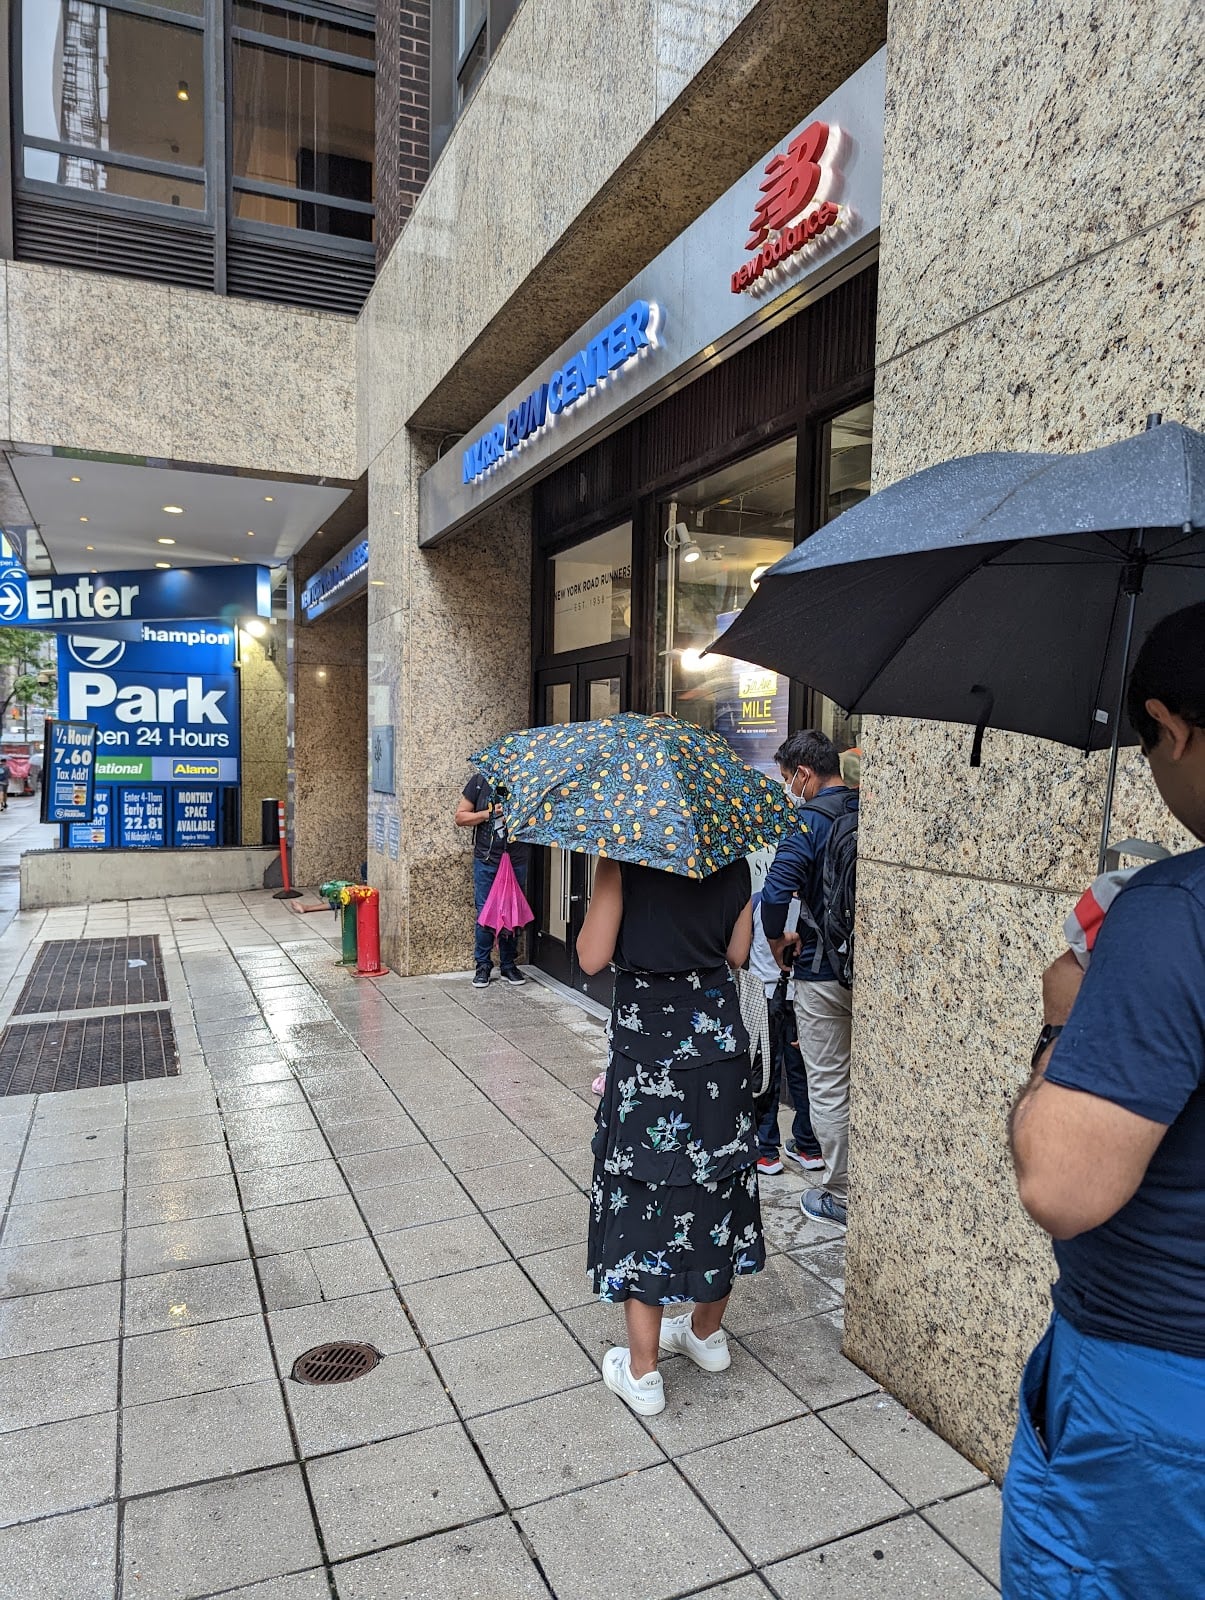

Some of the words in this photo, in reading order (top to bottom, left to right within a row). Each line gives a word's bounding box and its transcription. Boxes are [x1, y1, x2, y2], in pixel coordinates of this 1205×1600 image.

[731, 253, 764, 294] new
[763, 201, 838, 268] balance
[463, 423, 505, 484] NYRR
[505, 383, 549, 451] RUN
[548, 300, 650, 415] CENTER
[567, 582, 582, 598] YORK
[582, 577, 600, 592] ROAD
[601, 564, 631, 585] RUNNERS
[26, 577, 140, 619] Enter
[141, 626, 230, 646] hampion
[69, 671, 229, 725] Park
[742, 699, 772, 719] MILE
[68, 729, 93, 746] Hour
[136, 727, 162, 746] 24
[169, 728, 230, 747] Hours
[54, 748, 92, 766] 7.60
[56, 767, 69, 780] Tax
[174, 763, 218, 775] Alamo
[124, 791, 140, 802] Enter
[178, 791, 213, 804] MONTHLY
[124, 803, 144, 818] Early
[146, 803, 163, 815] Bird
[184, 806, 208, 818] SPACE
[124, 817, 163, 829] 22.81
[176, 820, 216, 832] AVAILABLE
